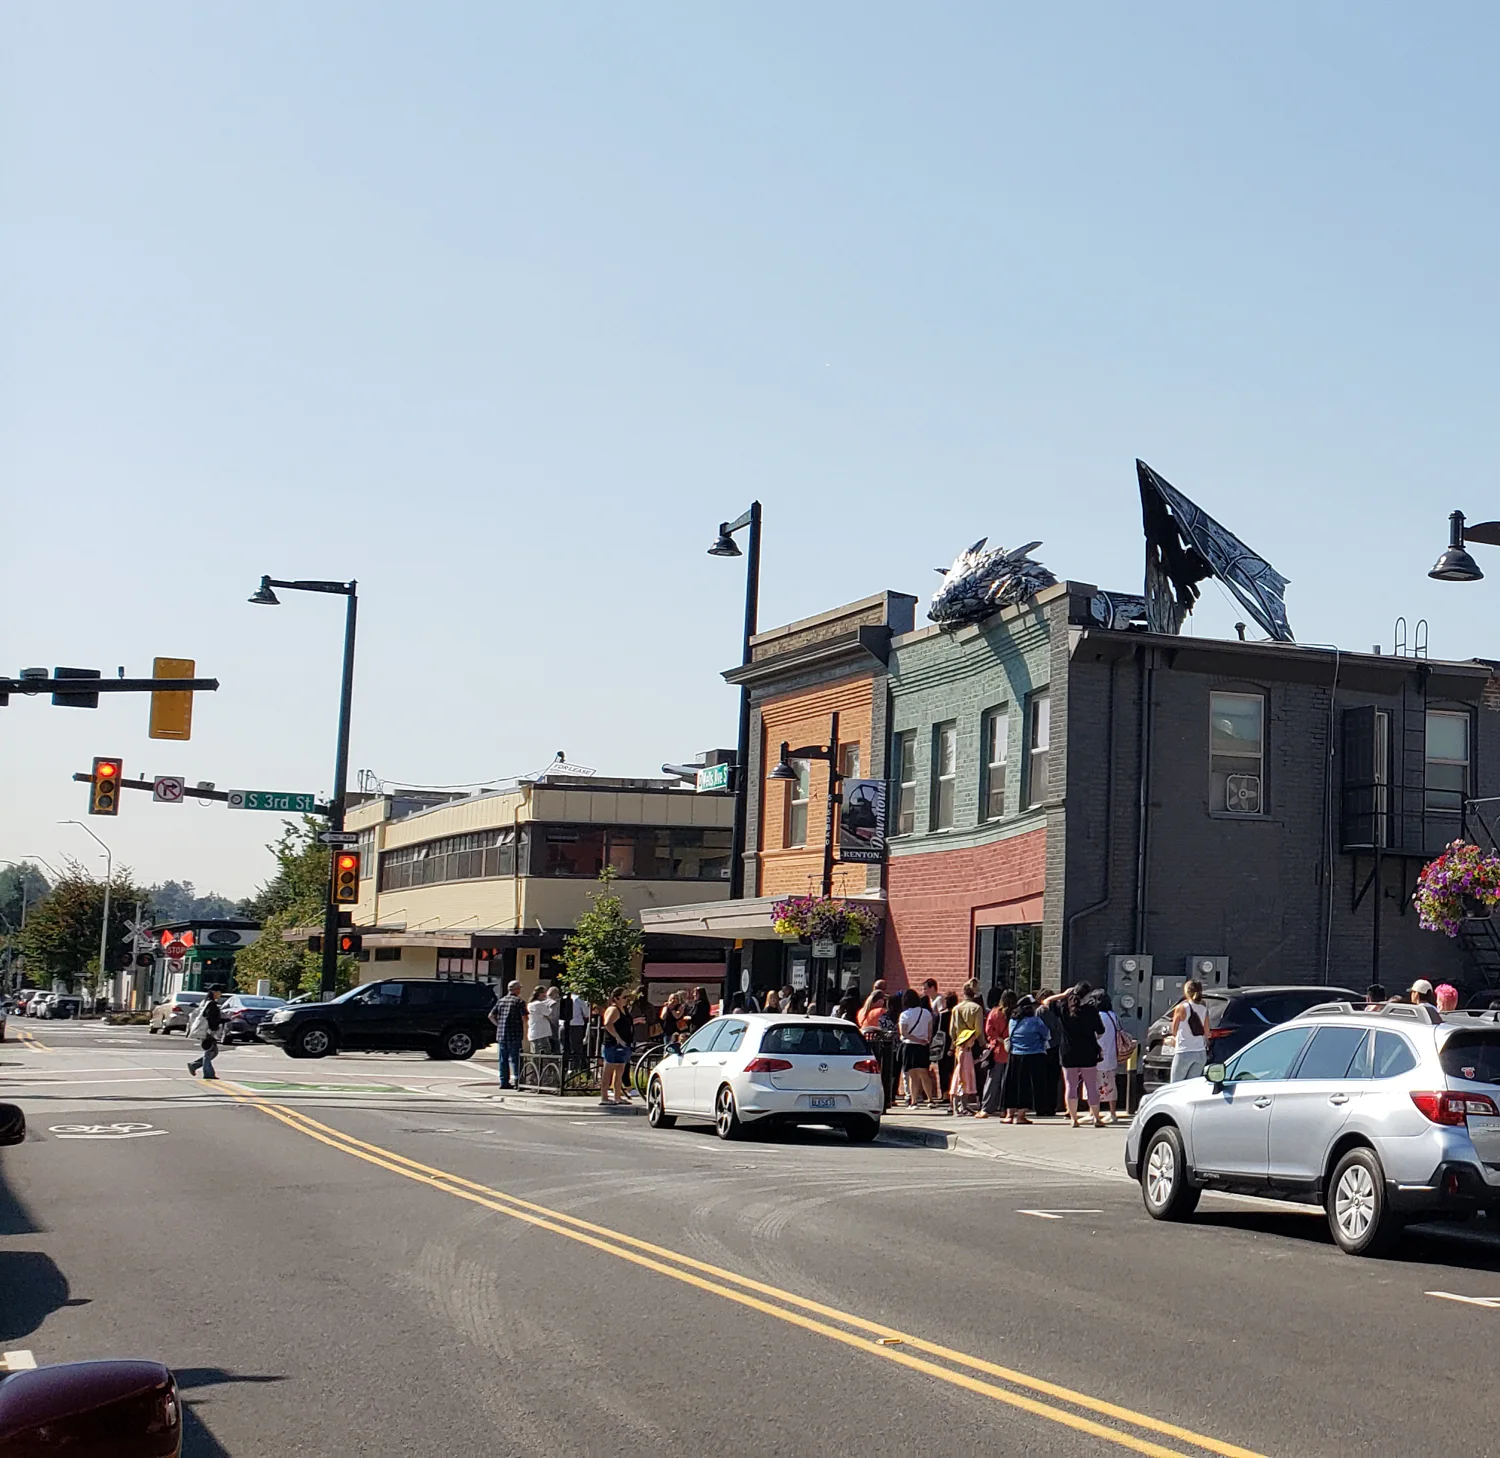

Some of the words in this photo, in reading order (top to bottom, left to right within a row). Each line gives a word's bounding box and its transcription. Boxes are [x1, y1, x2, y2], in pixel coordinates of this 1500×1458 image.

[249, 793, 258, 808] S
[264, 794, 289, 809] 3rd
[295, 795, 310, 810] St
[870, 781, 886, 849] Downtown
[168, 946, 186, 954] STOP
